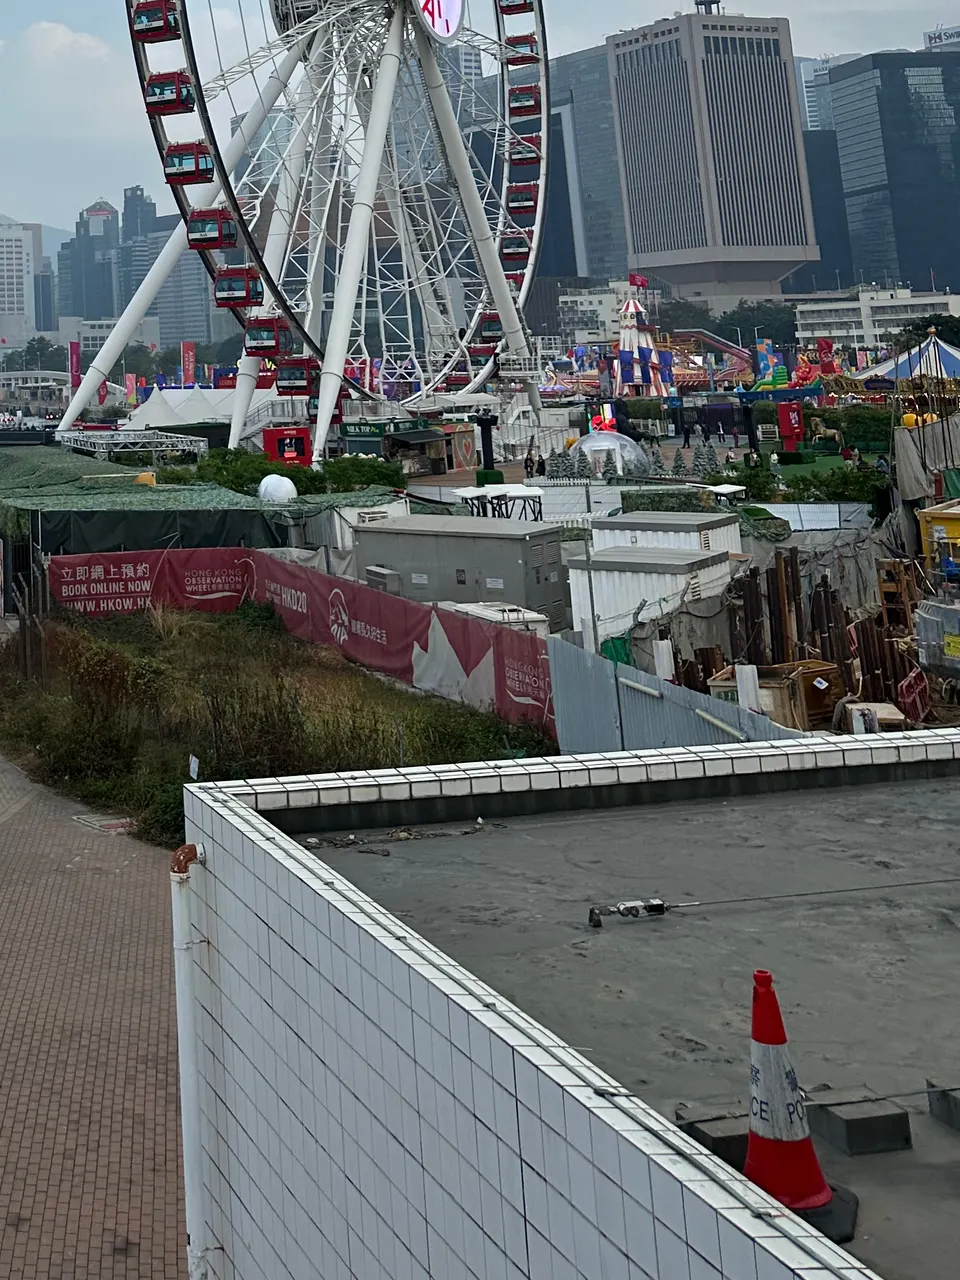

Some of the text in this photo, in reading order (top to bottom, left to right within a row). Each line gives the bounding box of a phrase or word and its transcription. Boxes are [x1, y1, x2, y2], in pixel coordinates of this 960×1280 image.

[60, 562, 150, 581] 立即網上預約
[184, 568, 242, 577] HONG KONG
[62, 580, 151, 596] BOOK ONLINE NOW
[184, 576, 241, 585] OBSERVATION
[185, 584, 211, 592] WHEEL
[281, 585, 307, 614] HKD20
[330, 623, 349, 645] AIA
